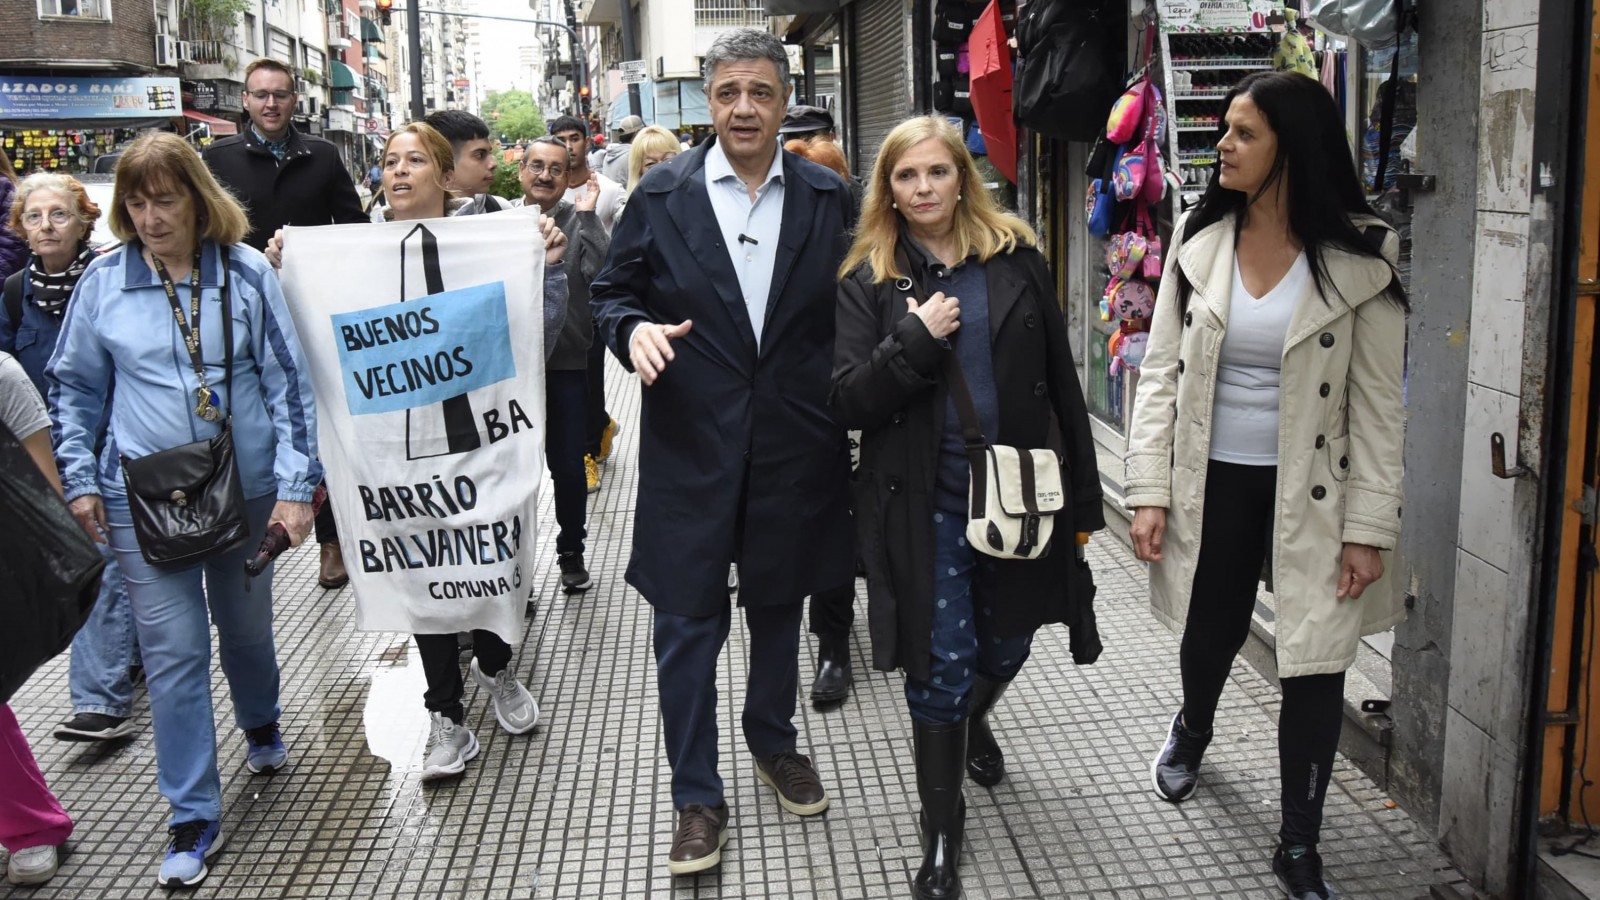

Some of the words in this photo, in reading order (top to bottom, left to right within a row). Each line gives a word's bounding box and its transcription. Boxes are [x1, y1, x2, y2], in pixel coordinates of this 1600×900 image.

[0, 83, 78, 93] LZADOS
[341, 307, 440, 352] BUENOS
[353, 346, 473, 400] VECINOS
[483, 399, 534, 444] BA
[359, 515, 521, 573] BALVANERA
[428, 576, 511, 600] COMUNA
